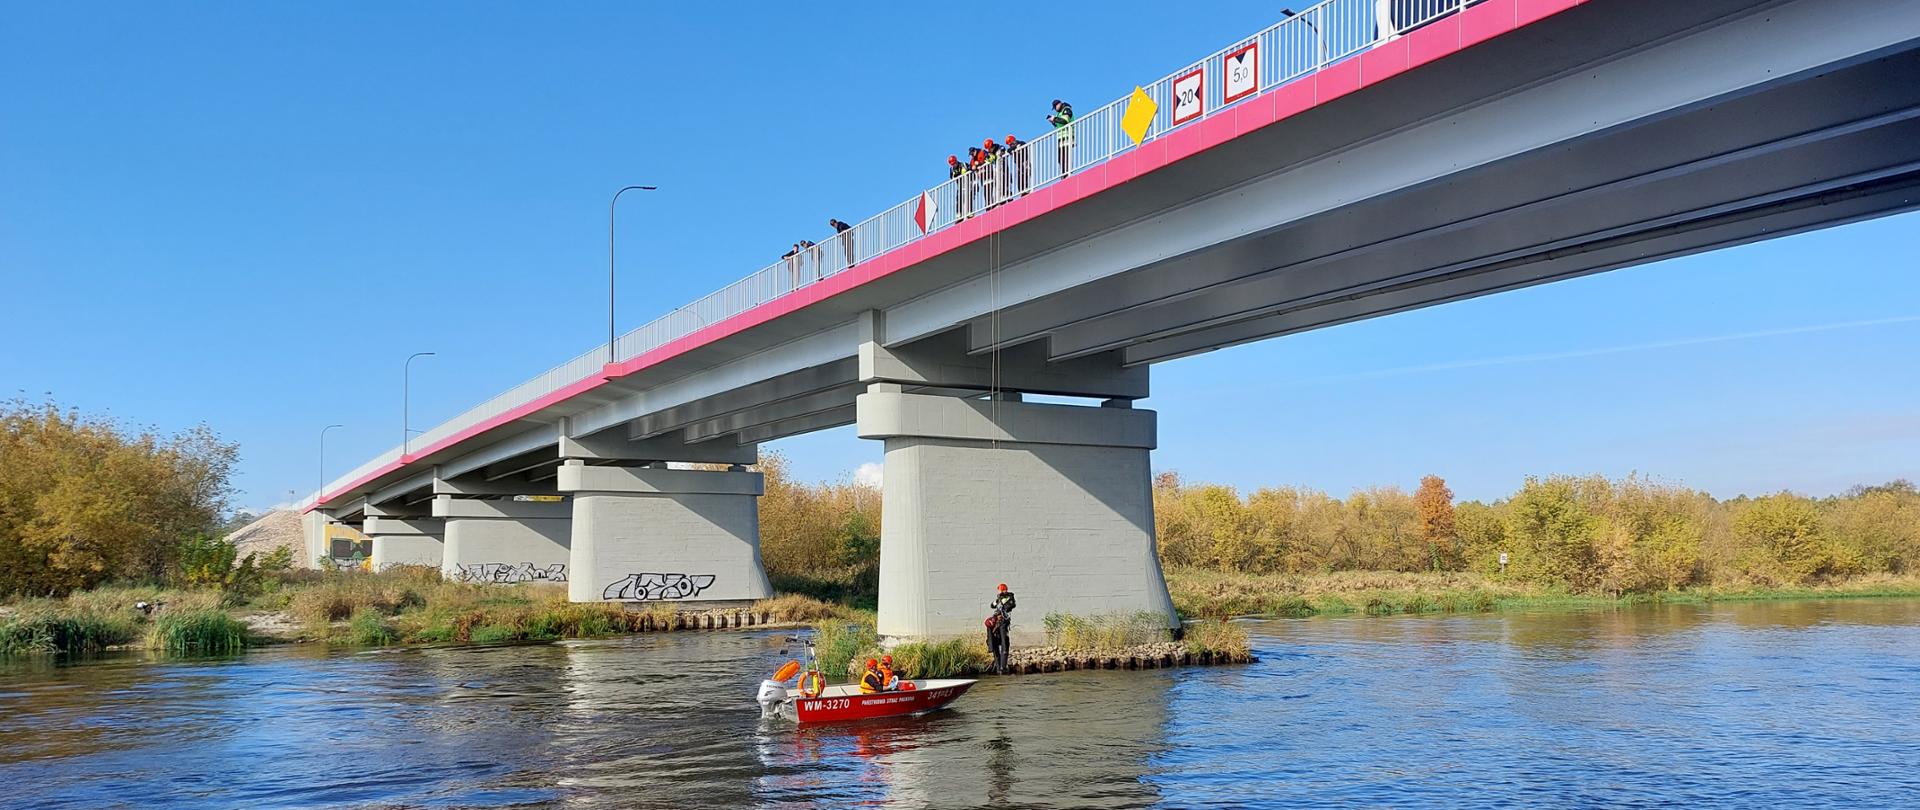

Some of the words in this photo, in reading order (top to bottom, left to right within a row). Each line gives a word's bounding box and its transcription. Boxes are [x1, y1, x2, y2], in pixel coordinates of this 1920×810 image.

[1234, 67, 1248, 83] 5,0
[1181, 89, 1193, 106] 20
[804, 699, 850, 711] WM-3270
